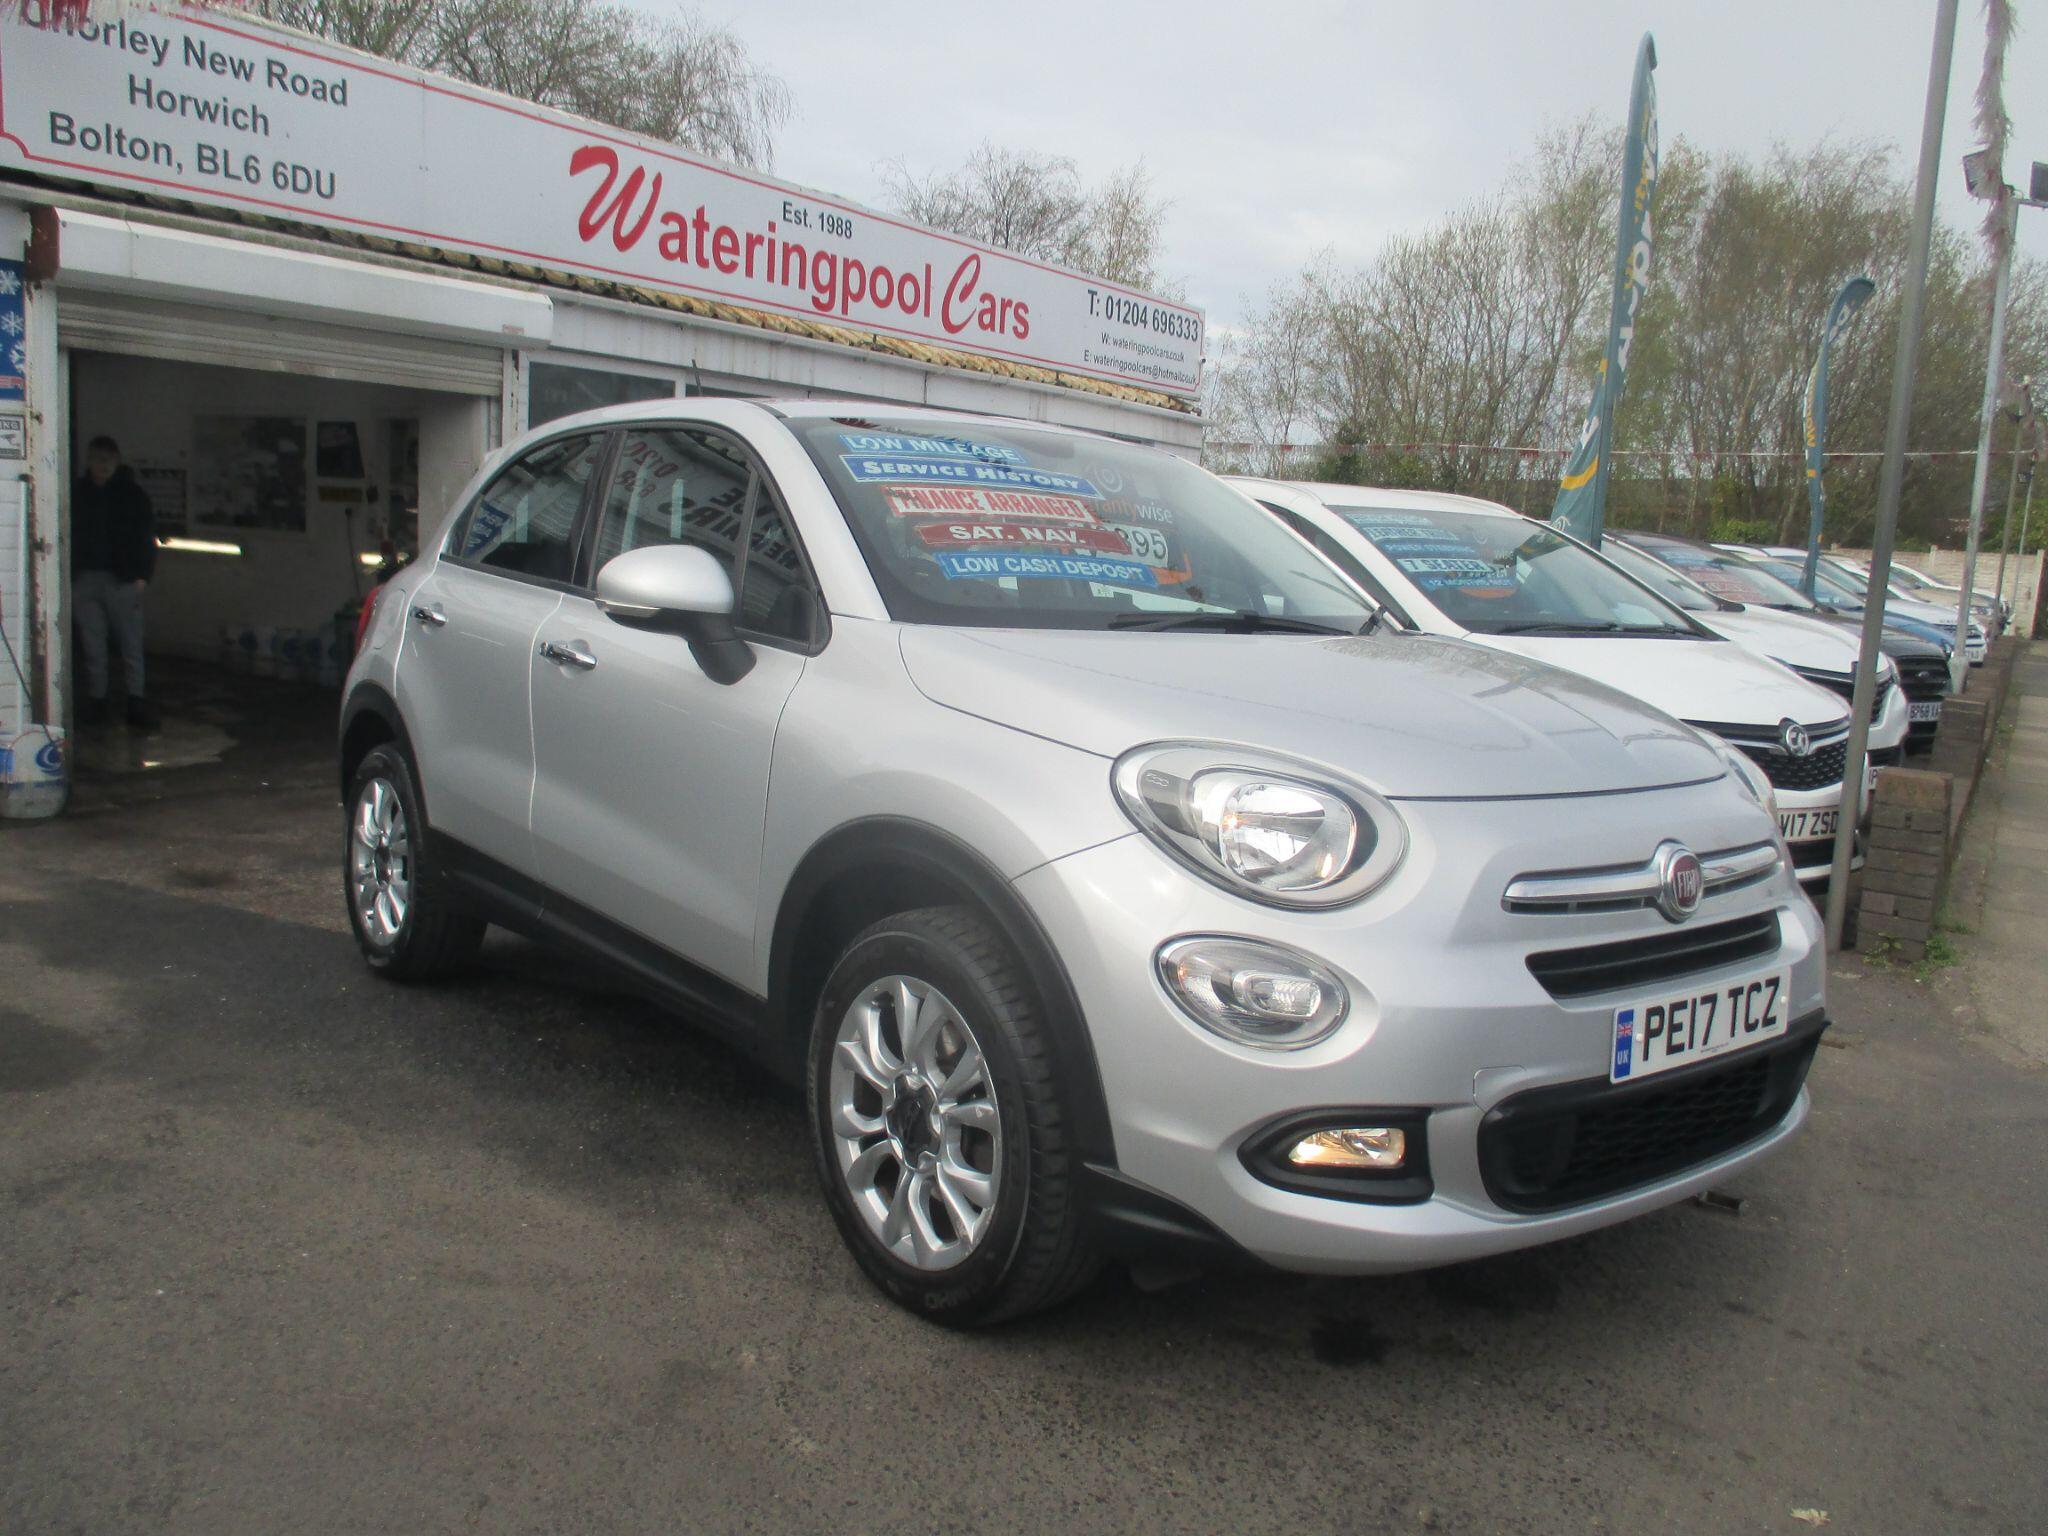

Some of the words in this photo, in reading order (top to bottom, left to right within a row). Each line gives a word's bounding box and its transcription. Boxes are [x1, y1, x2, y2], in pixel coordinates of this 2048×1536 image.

[183, 35, 255, 82] New
[267, 58, 348, 107] Road
[128, 74, 270, 136] Horwich
[49, 111, 184, 175] Bolton,
[197, 142, 261, 184] BL6
[272, 160, 336, 199] 6DU
[783, 201, 812, 228] Est.
[819, 212, 852, 239] 1988
[569, 146, 932, 317] Wateringpool
[941, 253, 1030, 340] Cars
[1087, 289, 1100, 317] T:
[1105, 295, 1148, 329] 01204
[1152, 307, 1199, 342] 696333
[848, 436, 902, 451] LOW
[910, 439, 1021, 461] MILEAGE
[899, 488, 985, 512] FINANCE
[984, 490, 1087, 518] ARRANGED
[950, 525, 1014, 540] SAT.
[1021, 528, 1086, 544] NAV.
[951, 556, 1000, 573] LOW
[1005, 557, 1063, 574] CASH
[1063, 560, 1146, 581] DEPOSIT
[1421, 559, 1487, 571] SEATER
[1643, 993, 1718, 1061] PE17
[1728, 976, 1780, 1038] TCZ
[1617, 1050, 1629, 1065] UK
